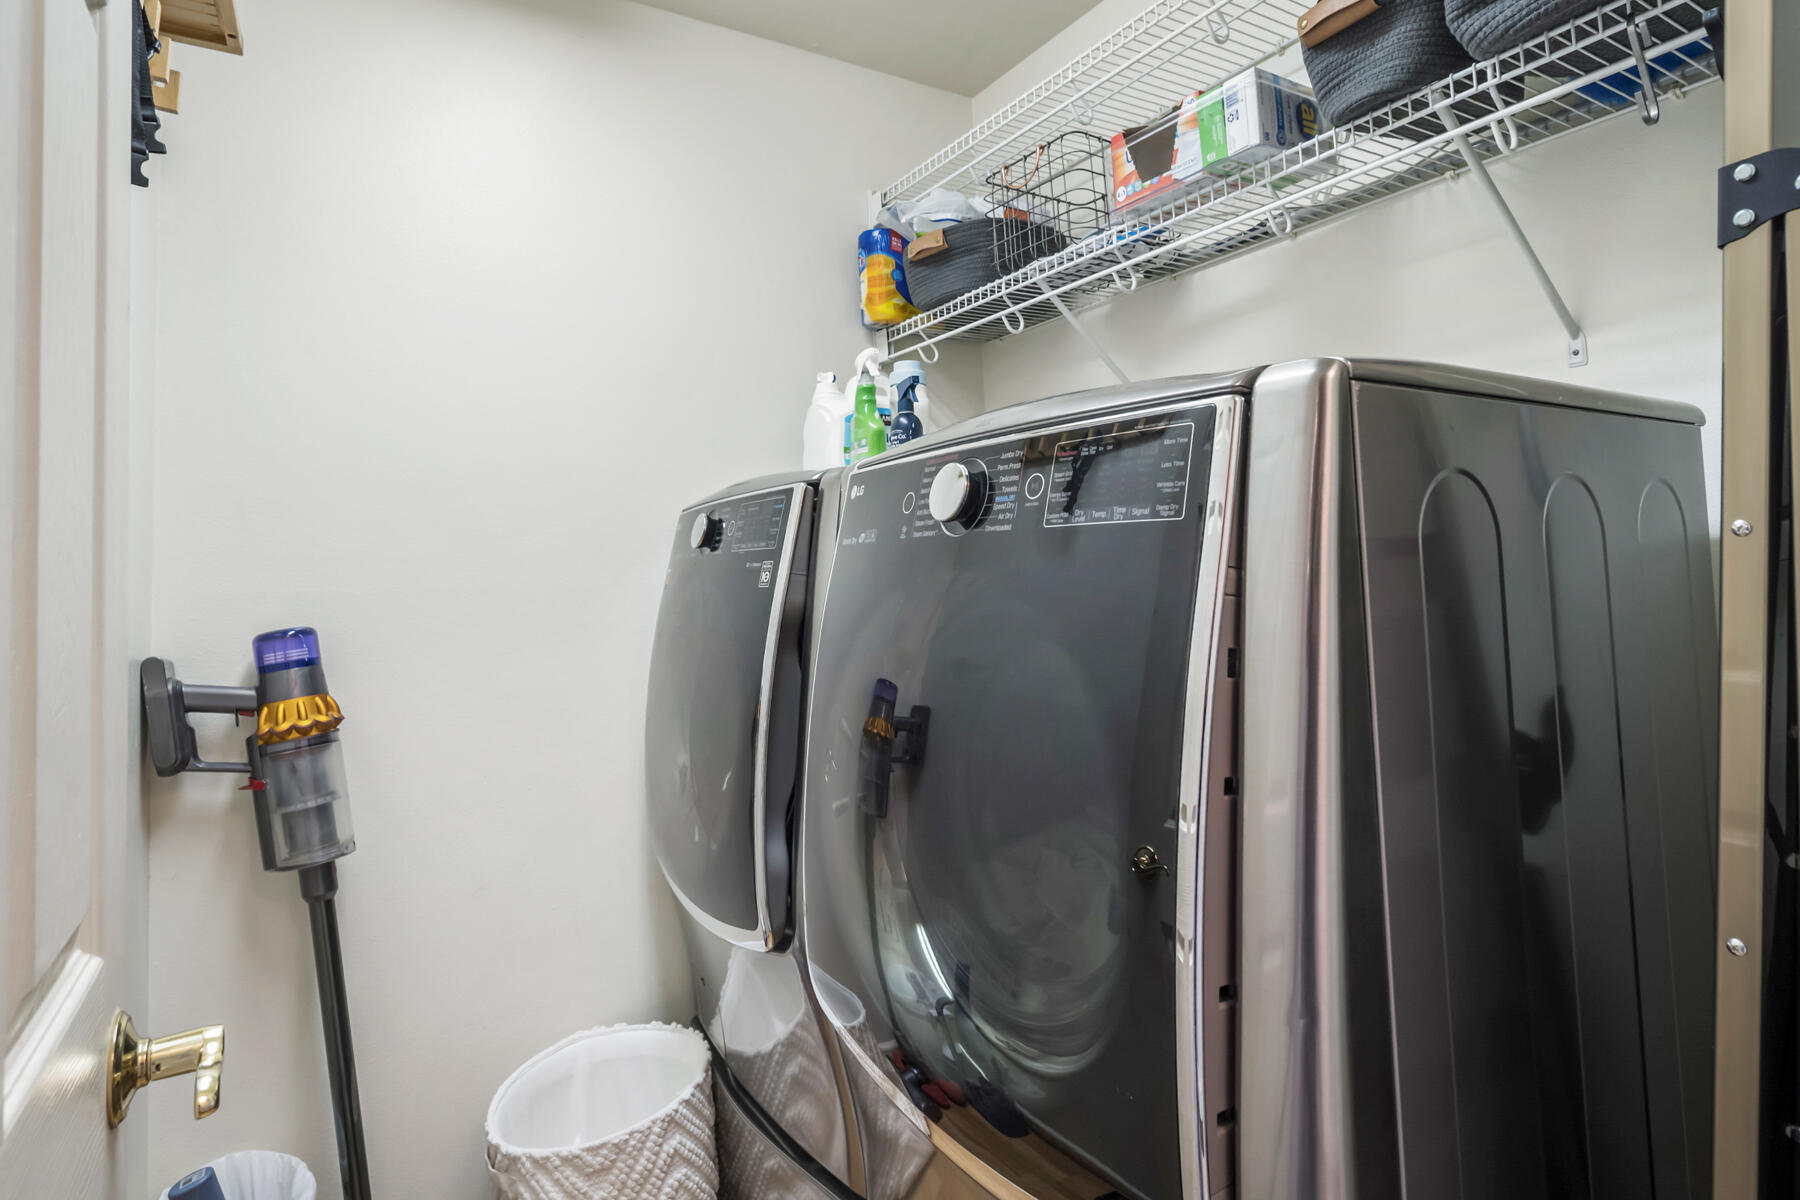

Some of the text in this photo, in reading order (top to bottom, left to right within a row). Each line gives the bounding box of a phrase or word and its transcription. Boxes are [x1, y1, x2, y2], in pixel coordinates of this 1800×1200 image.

[1301, 103, 1319, 136] all
[1000, 451, 1015, 459] Jumbo
[993, 503, 1006, 511] Speed
[1006, 501, 1015, 509] Dry
[1074, 509, 1084, 517] Dry
[1131, 507, 1150, 516] Signal
[1004, 512, 1013, 520] Dry
